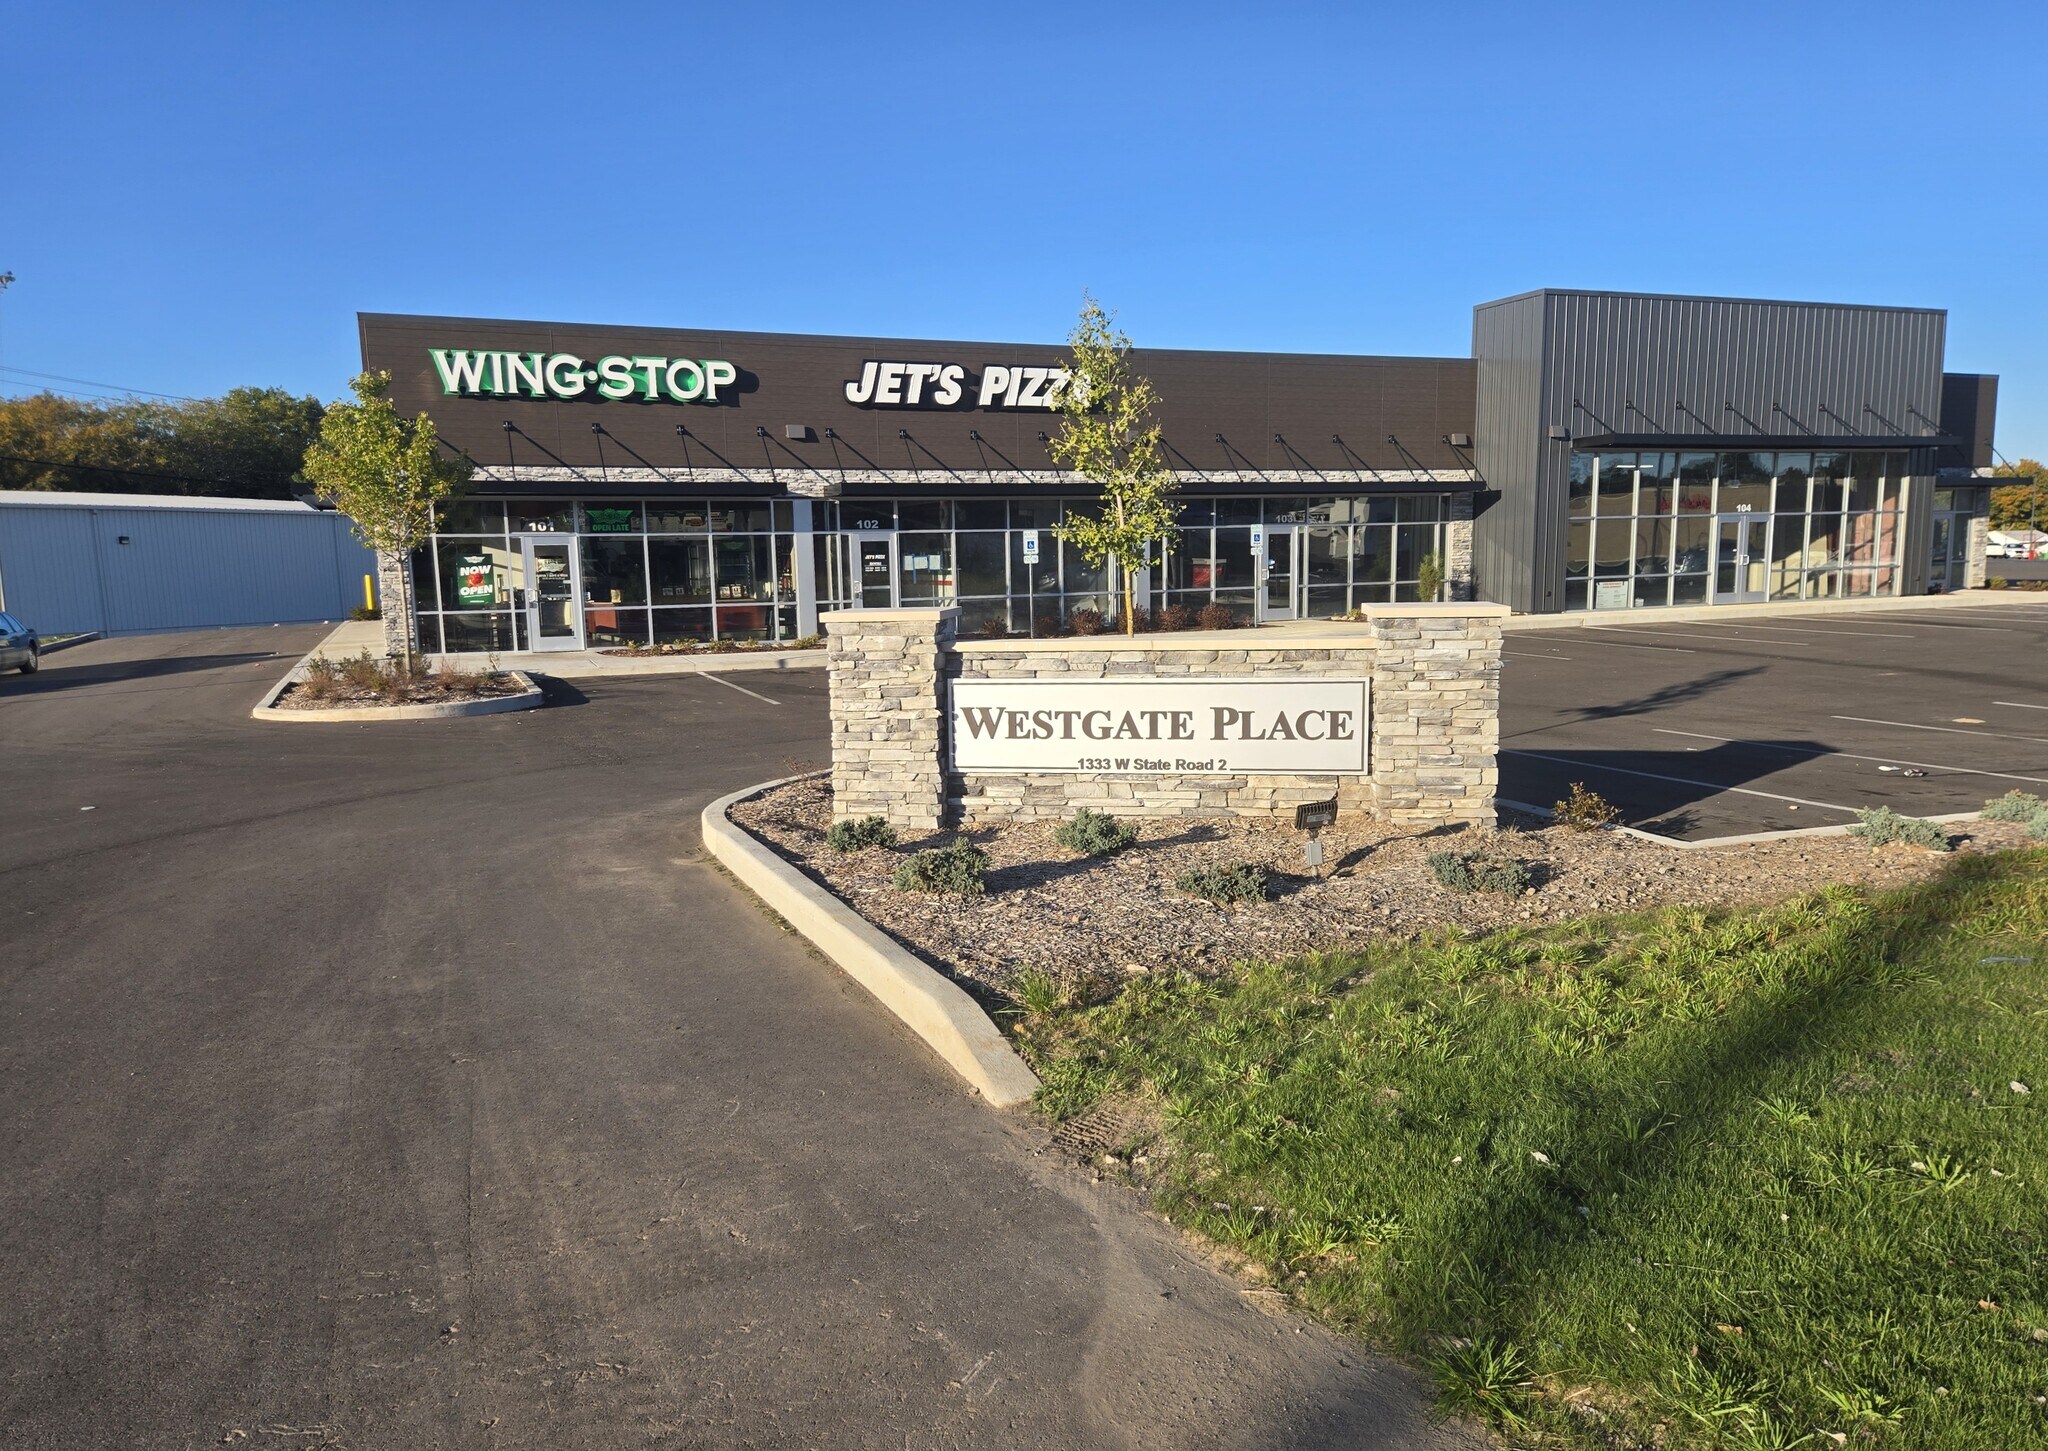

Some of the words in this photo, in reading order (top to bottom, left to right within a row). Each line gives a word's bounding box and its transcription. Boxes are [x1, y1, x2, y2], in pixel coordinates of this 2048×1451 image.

[845, 361, 964, 405] JET'S
[1736, 504, 1752, 512] 104
[1276, 514, 1293, 523] 103
[529, 521, 555, 532] 101
[592, 524, 611, 532] OPEN
[612, 524, 629, 532] LATE
[856, 520, 879, 529] 102
[460, 565, 491, 576] NOW
[460, 585, 493, 596] OPEN
[960, 706, 1195, 740] WESTGATE
[1210, 706, 1354, 741] PLACE
[1078, 758, 1111, 770] 1333
[1115, 758, 1130, 770] W
[1134, 758, 1171, 770] State
[1175, 759, 1214, 770] Road
[1218, 759, 1227, 770] 2
